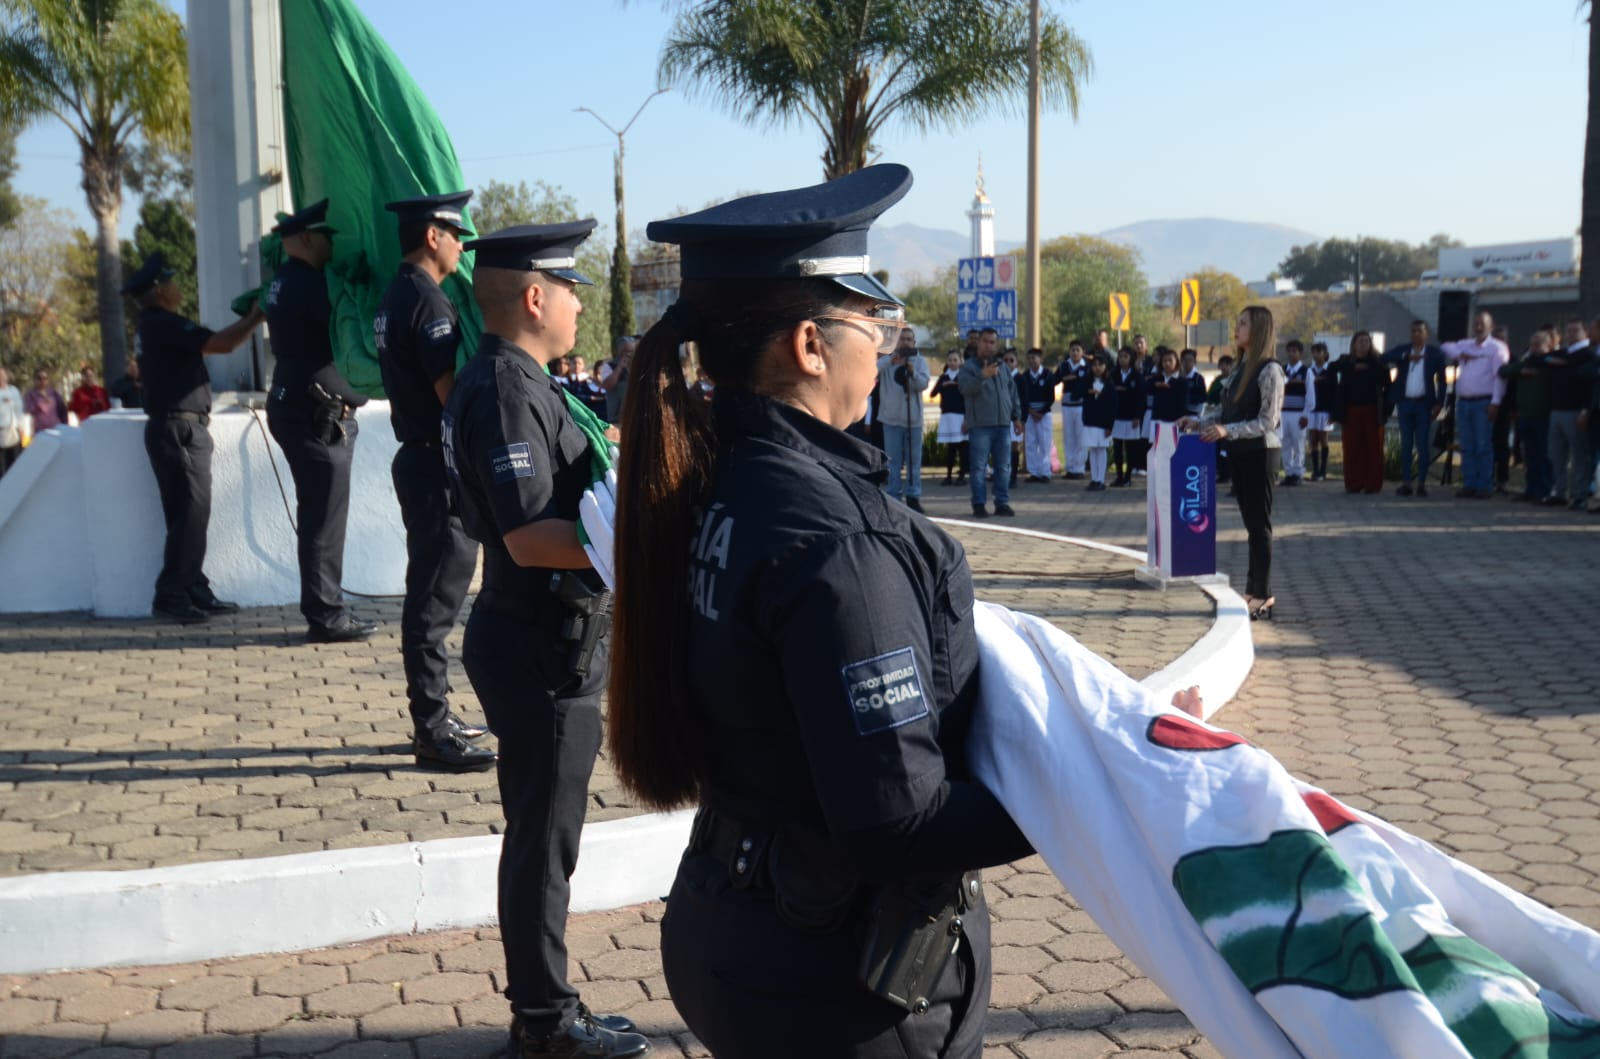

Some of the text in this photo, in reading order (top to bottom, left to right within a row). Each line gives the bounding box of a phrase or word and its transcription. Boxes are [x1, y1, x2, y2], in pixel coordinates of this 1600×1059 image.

[495, 459, 531, 473] SOCIAL
[850, 666, 914, 694] PROXIMIDAD
[855, 681, 920, 713] SOCIAL
